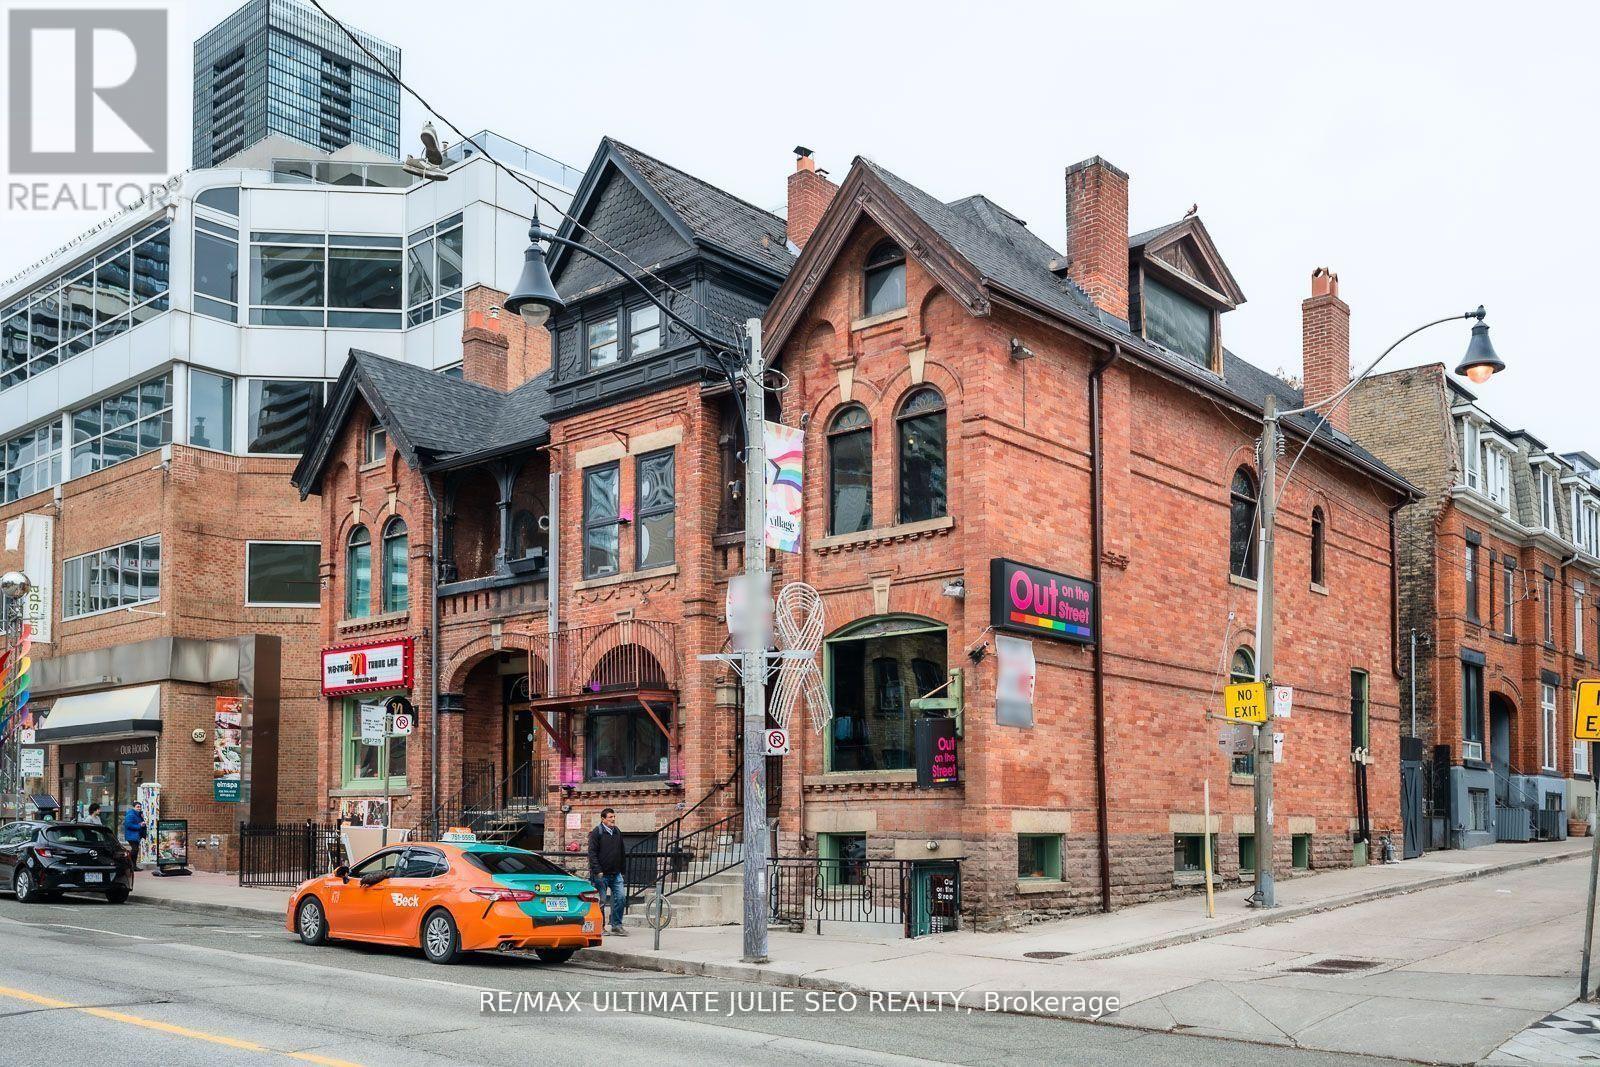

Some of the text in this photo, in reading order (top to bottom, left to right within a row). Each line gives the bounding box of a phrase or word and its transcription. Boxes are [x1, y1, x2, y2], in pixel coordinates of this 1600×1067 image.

[1010, 570, 1058, 617] Out
[1061, 584, 1090, 602] on the
[1058, 601, 1090, 624] Street
[1237, 689, 1253, 701] NO
[1234, 705, 1258, 718] EXIT
[120, 743, 150, 755] OUR HOURS
[937, 736, 955, 751] Out
[934, 752, 956, 763] on the
[932, 763, 956, 778] Street
[391, 892, 420, 907] Beck
